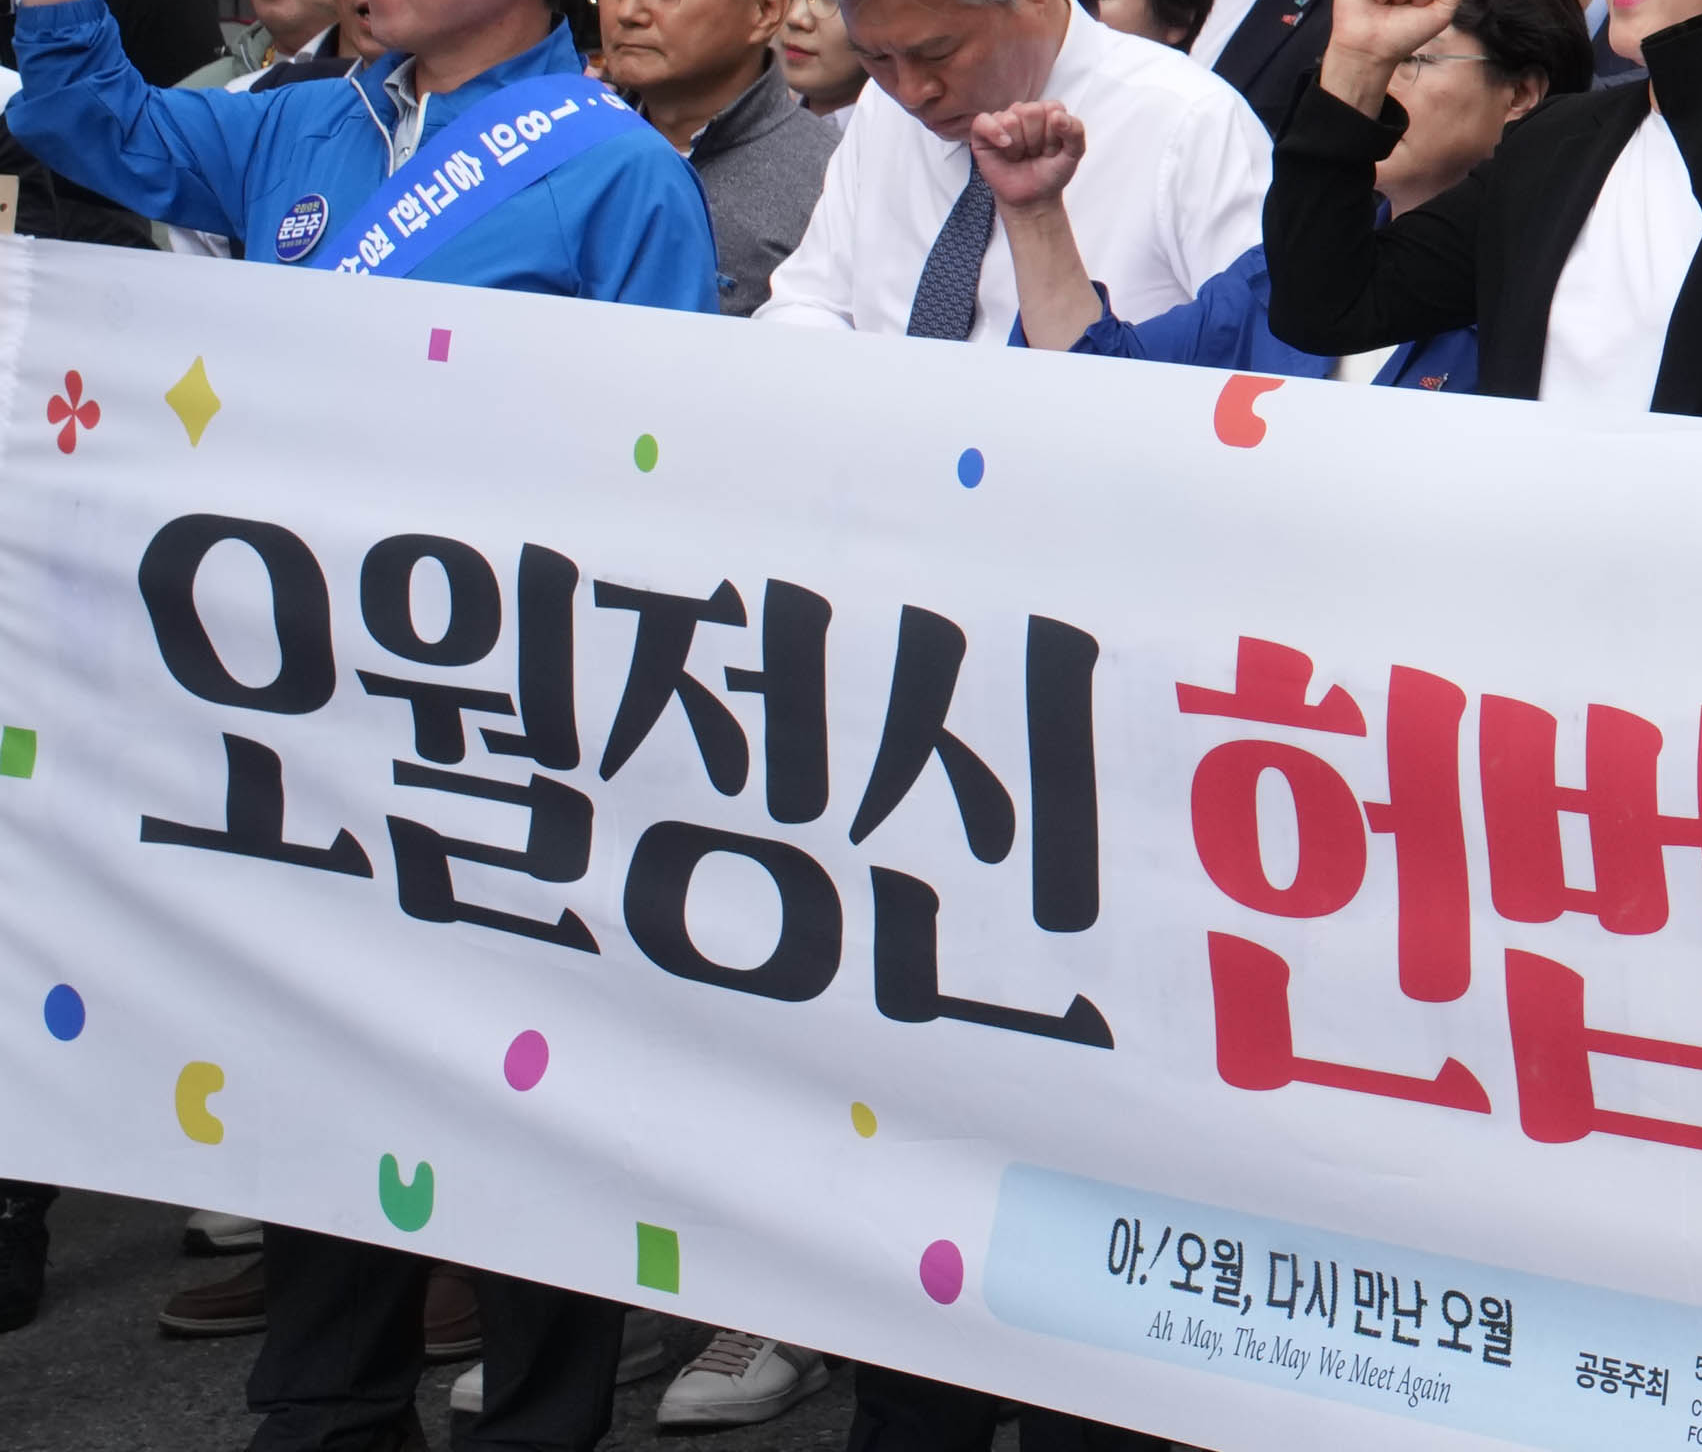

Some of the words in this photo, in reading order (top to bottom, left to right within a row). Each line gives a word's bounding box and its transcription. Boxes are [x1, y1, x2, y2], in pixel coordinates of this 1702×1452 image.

[278, 213, 322, 240] 문금주
[388, 150, 485, 238] 숭고한
[138, 512, 1116, 1050] 오월정신
[1107, 1217, 1171, 1285] 아!
[1170, 1232, 1252, 1317] 오월,
[1267, 1250, 1339, 1328] 다시
[1352, 1265, 1428, 1348] 만난
[1437, 1287, 1514, 1368] 오월
[1147, 1309, 1174, 1341] Ah
[1180, 1316, 1223, 1358] May,
[1233, 1326, 1267, 1362] The
[1268, 1336, 1312, 1381] May
[1319, 1345, 1346, 1381] We
[1348, 1354, 1395, 1392] Meet
[1397, 1364, 1452, 1408] Again
[1575, 1351, 1669, 1406] 공동주최
